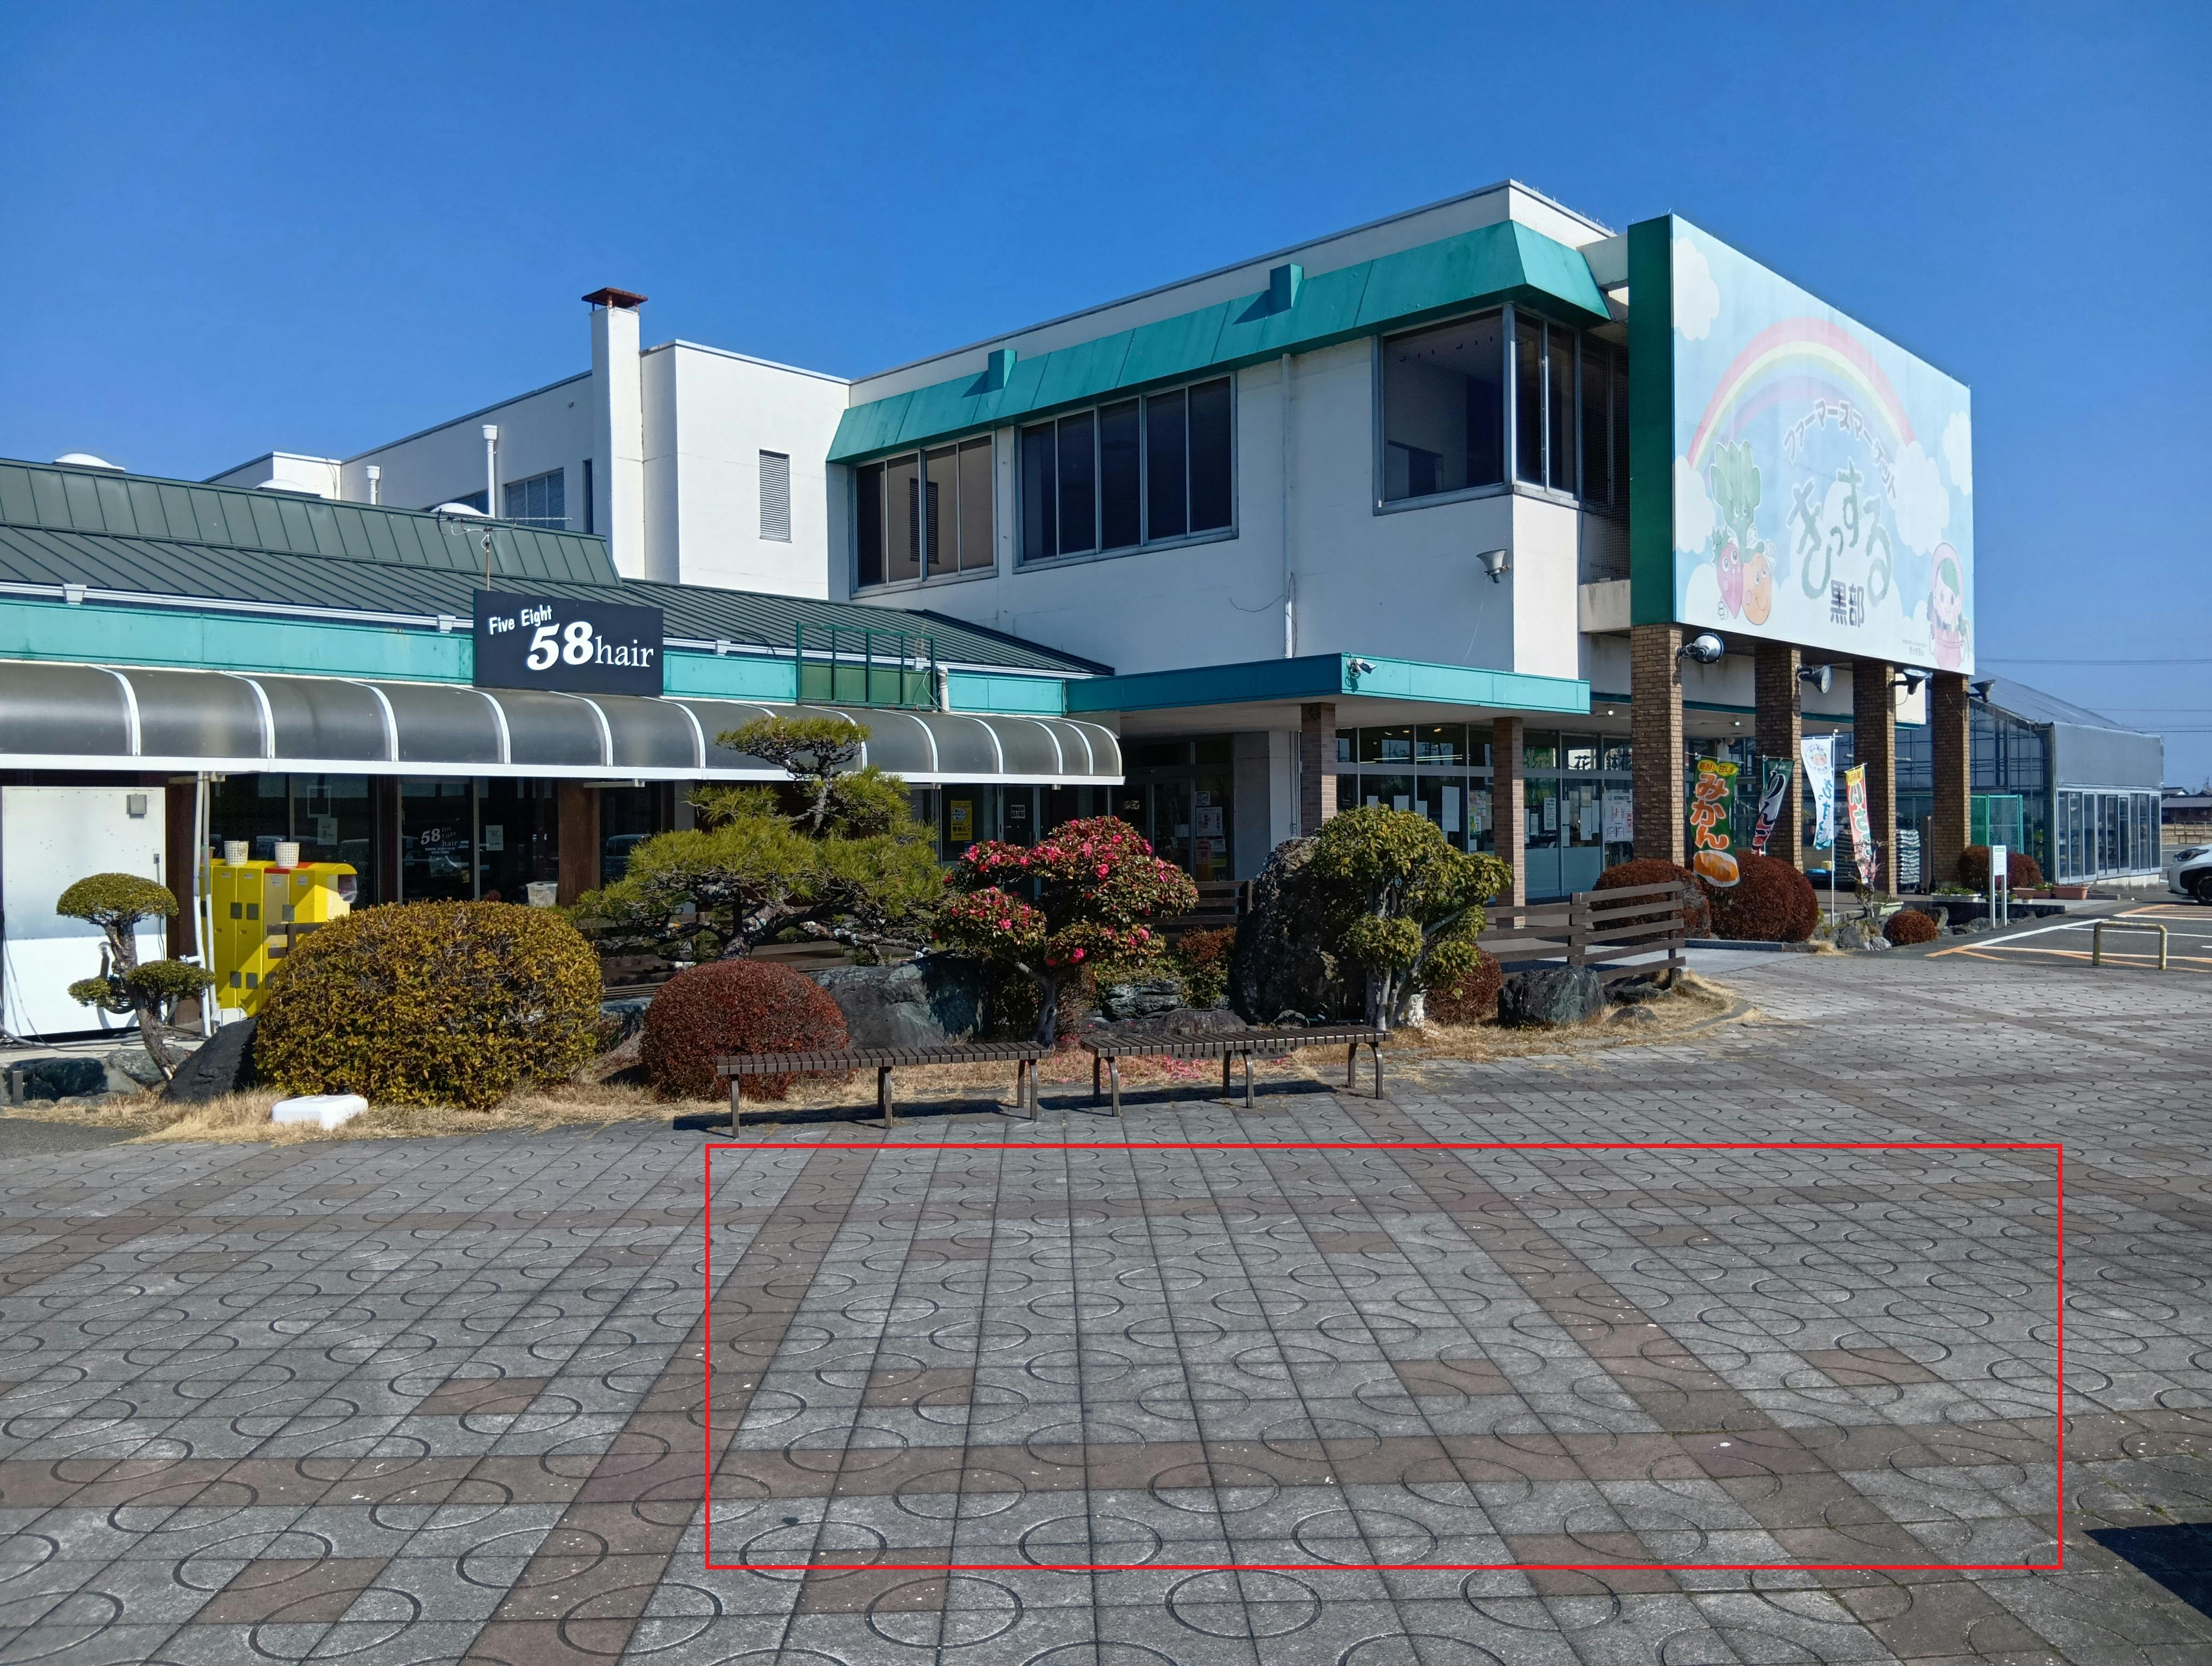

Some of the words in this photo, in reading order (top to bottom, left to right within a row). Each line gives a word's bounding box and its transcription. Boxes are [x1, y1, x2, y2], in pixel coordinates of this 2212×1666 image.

[489, 616, 515, 635] Five
[522, 605, 552, 627] Eight
[1830, 579, 1864, 627] 黒部
[1690, 773, 1729, 850] みかん
[421, 828, 441, 845] 58
